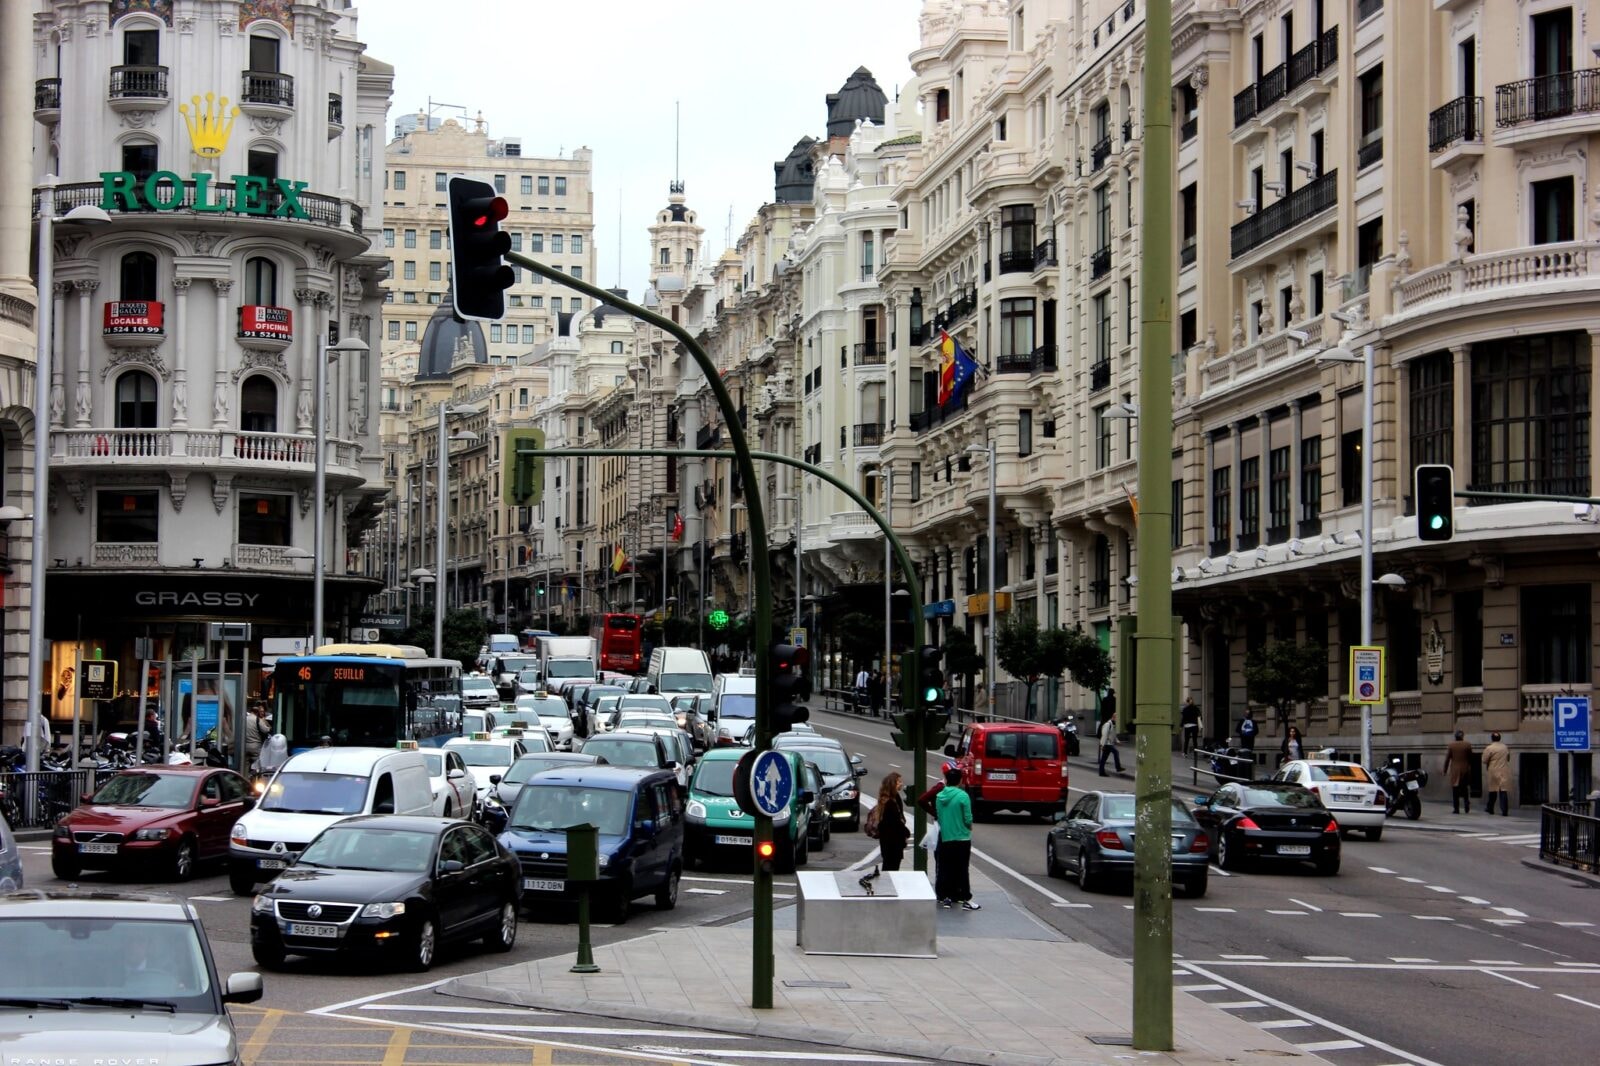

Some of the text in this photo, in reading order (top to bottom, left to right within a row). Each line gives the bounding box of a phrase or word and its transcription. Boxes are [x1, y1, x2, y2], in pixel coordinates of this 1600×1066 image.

[99, 170, 311, 221] ROLEX
[255, 323, 289, 332] OFICINAS
[135, 591, 260, 607] GRASSY
[298, 667, 364, 680] 46 SEVILLA
[1558, 703, 1578, 728] P
[527, 880, 546, 889] 1112
[294, 924, 335, 937] 9463 DKR
[11, 1058, 160, 1066] RANGE ROVER
